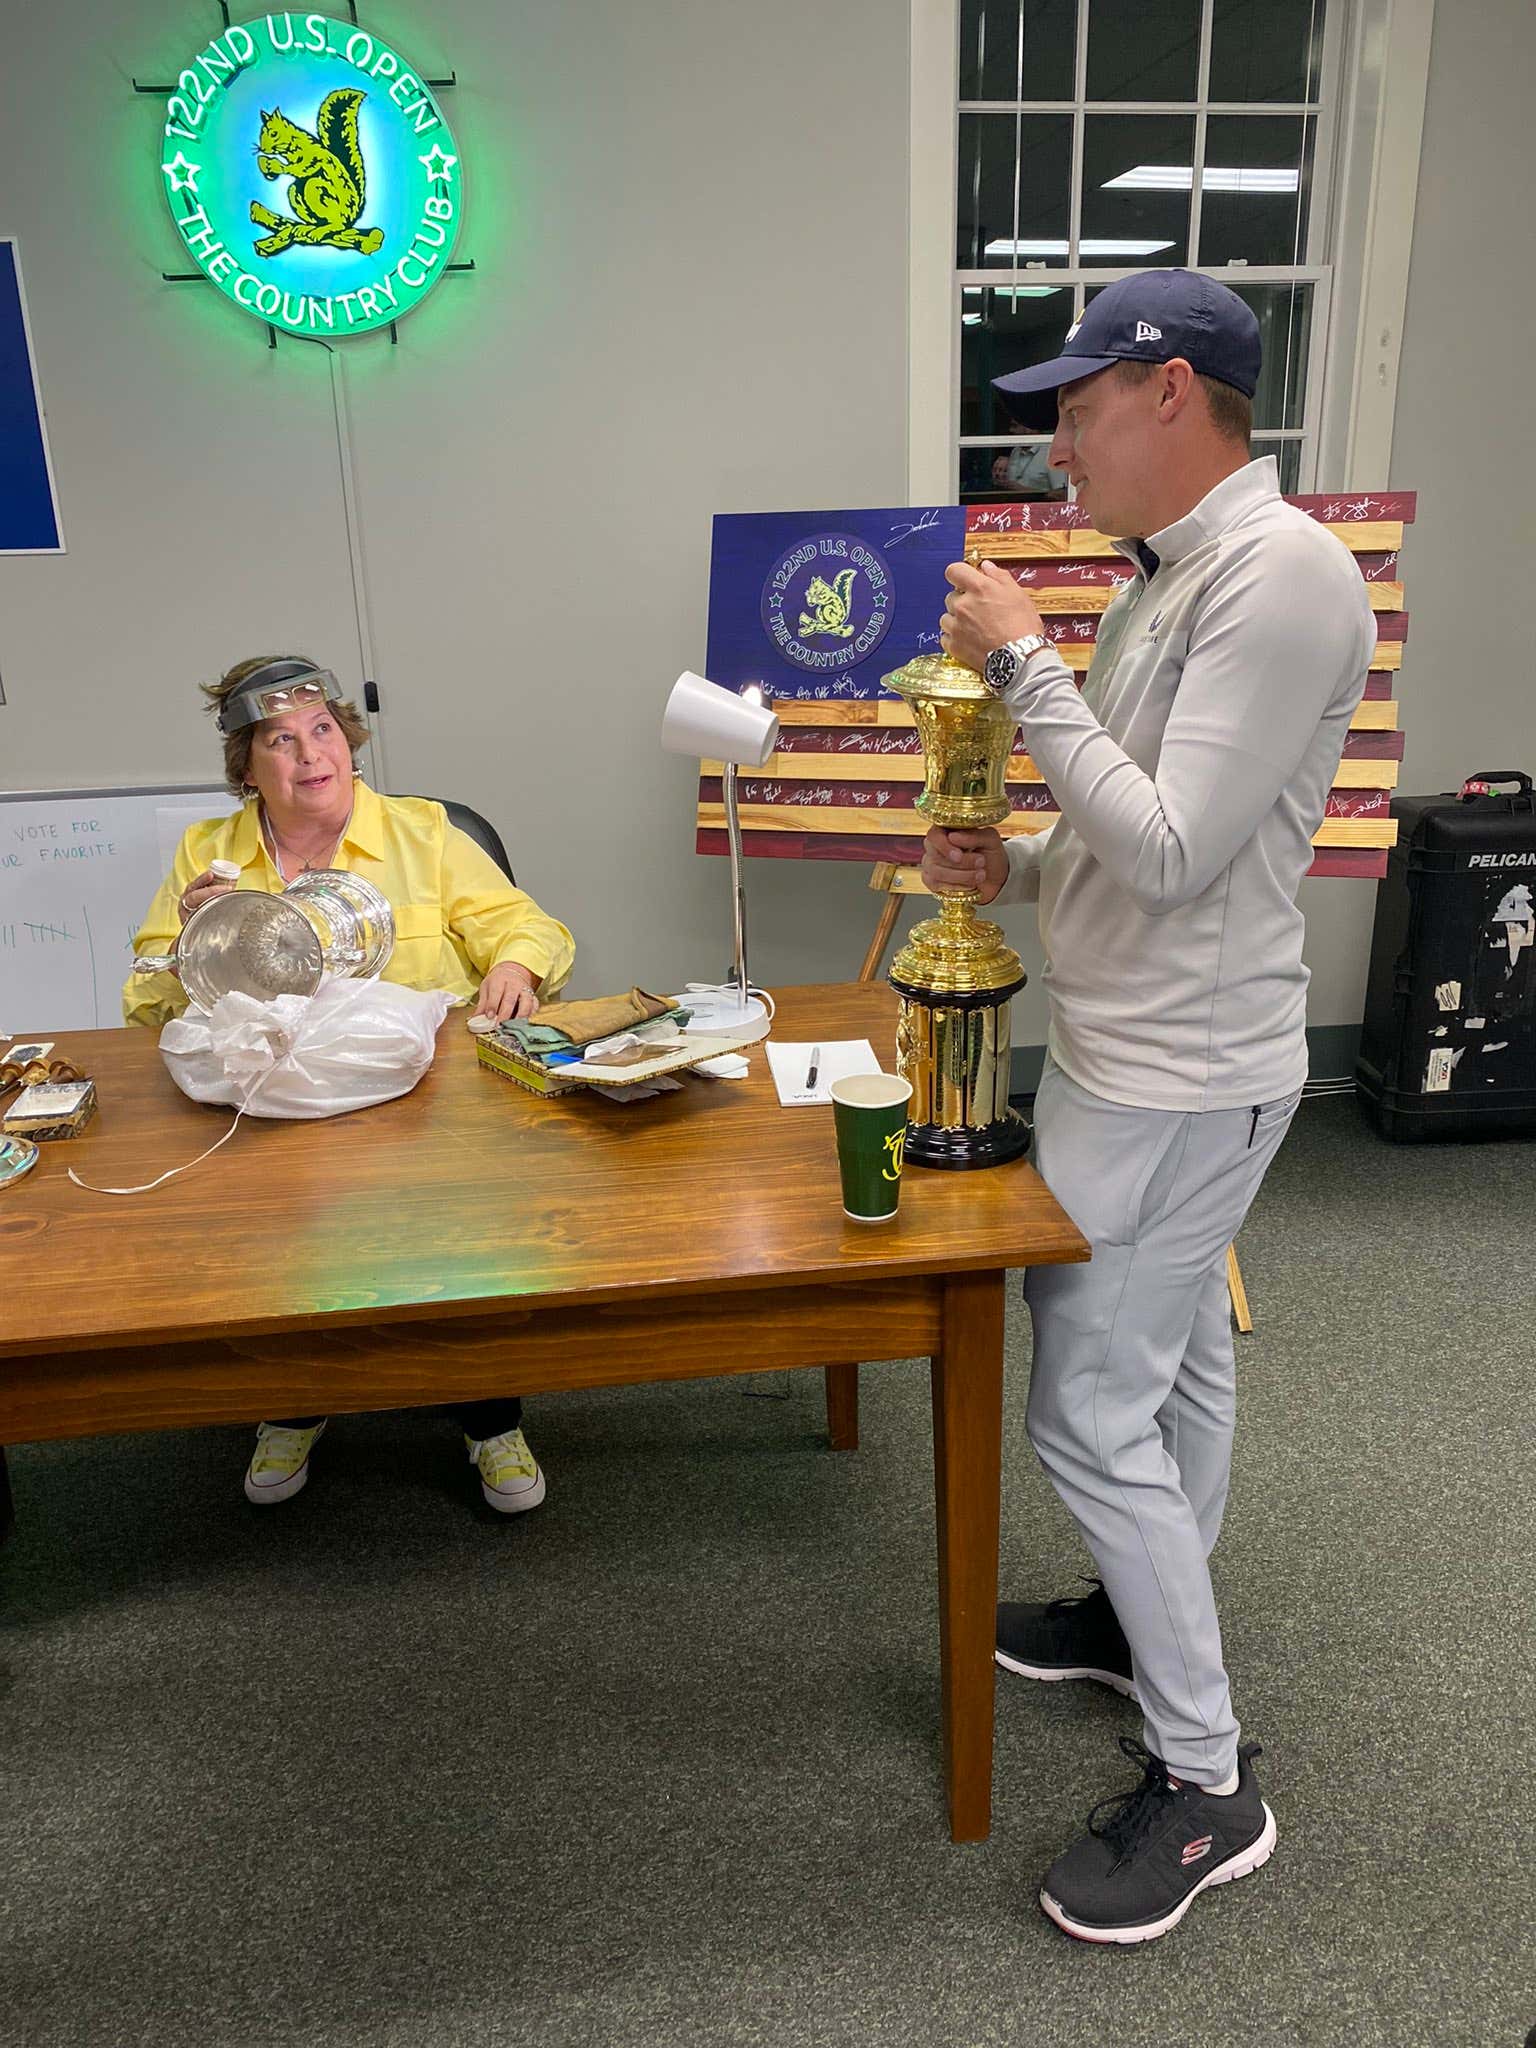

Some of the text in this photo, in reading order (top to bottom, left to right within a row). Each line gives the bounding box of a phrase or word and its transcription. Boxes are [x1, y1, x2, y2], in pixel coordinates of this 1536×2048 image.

[166, 12, 438, 140] 122ND U.S. OPEN
[179, 196, 453, 329] THE COUNTRY CLUB
[772, 539, 888, 590] 122ND U.S. OPEN
[769, 611, 792, 647] THE
[785, 641, 856, 667] COUNTRY
[854, 611, 886, 653] CLUB
[14, 819, 102, 841] VOTE FOR
[39, 843, 117, 860] FAVORITE
[1467, 853, 1536, 869] PELICAN
